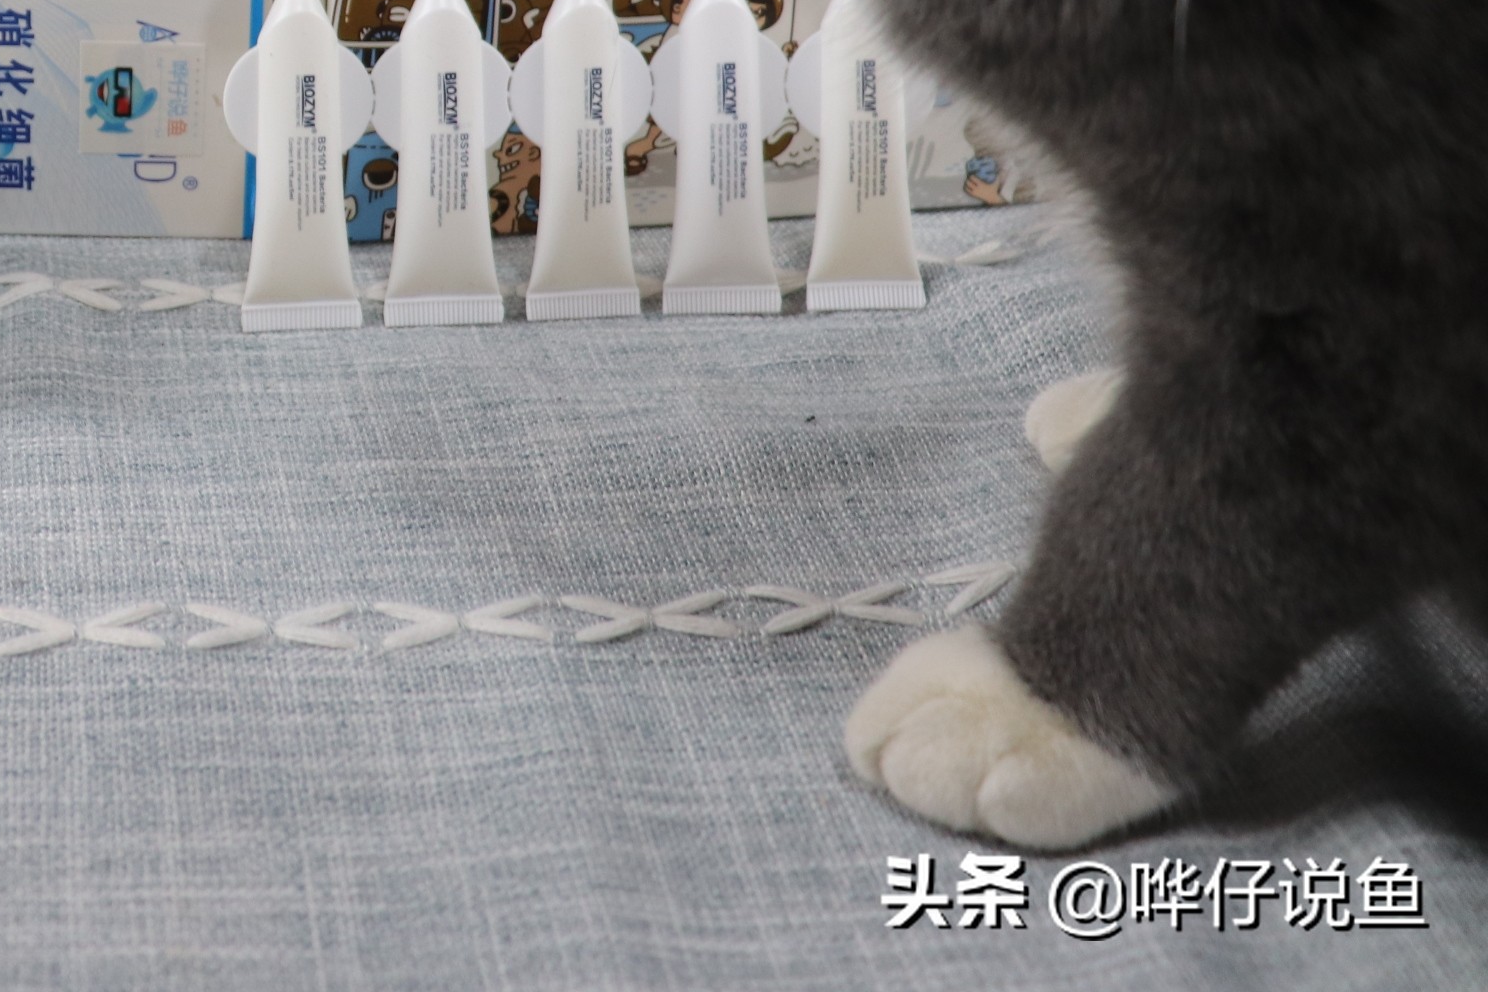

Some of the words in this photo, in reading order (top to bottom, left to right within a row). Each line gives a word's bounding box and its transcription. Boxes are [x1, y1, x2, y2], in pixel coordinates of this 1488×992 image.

[303, 74, 316, 128] BIOZYM
[444, 72, 458, 125] BIOZYM
[590, 68, 603, 120] BIOZYM
[723, 63, 736, 117] BIOZYM
[862, 60, 876, 112] BIOZYM
[317, 136, 326, 171] BS101
[460, 133, 469, 168] BS101
[605, 128, 613, 162] BS101
[739, 123, 747, 157] BS101
[879, 120, 888, 154] BS101
[318, 175, 326, 214] Bacteria
[605, 166, 613, 204] Bacteria
